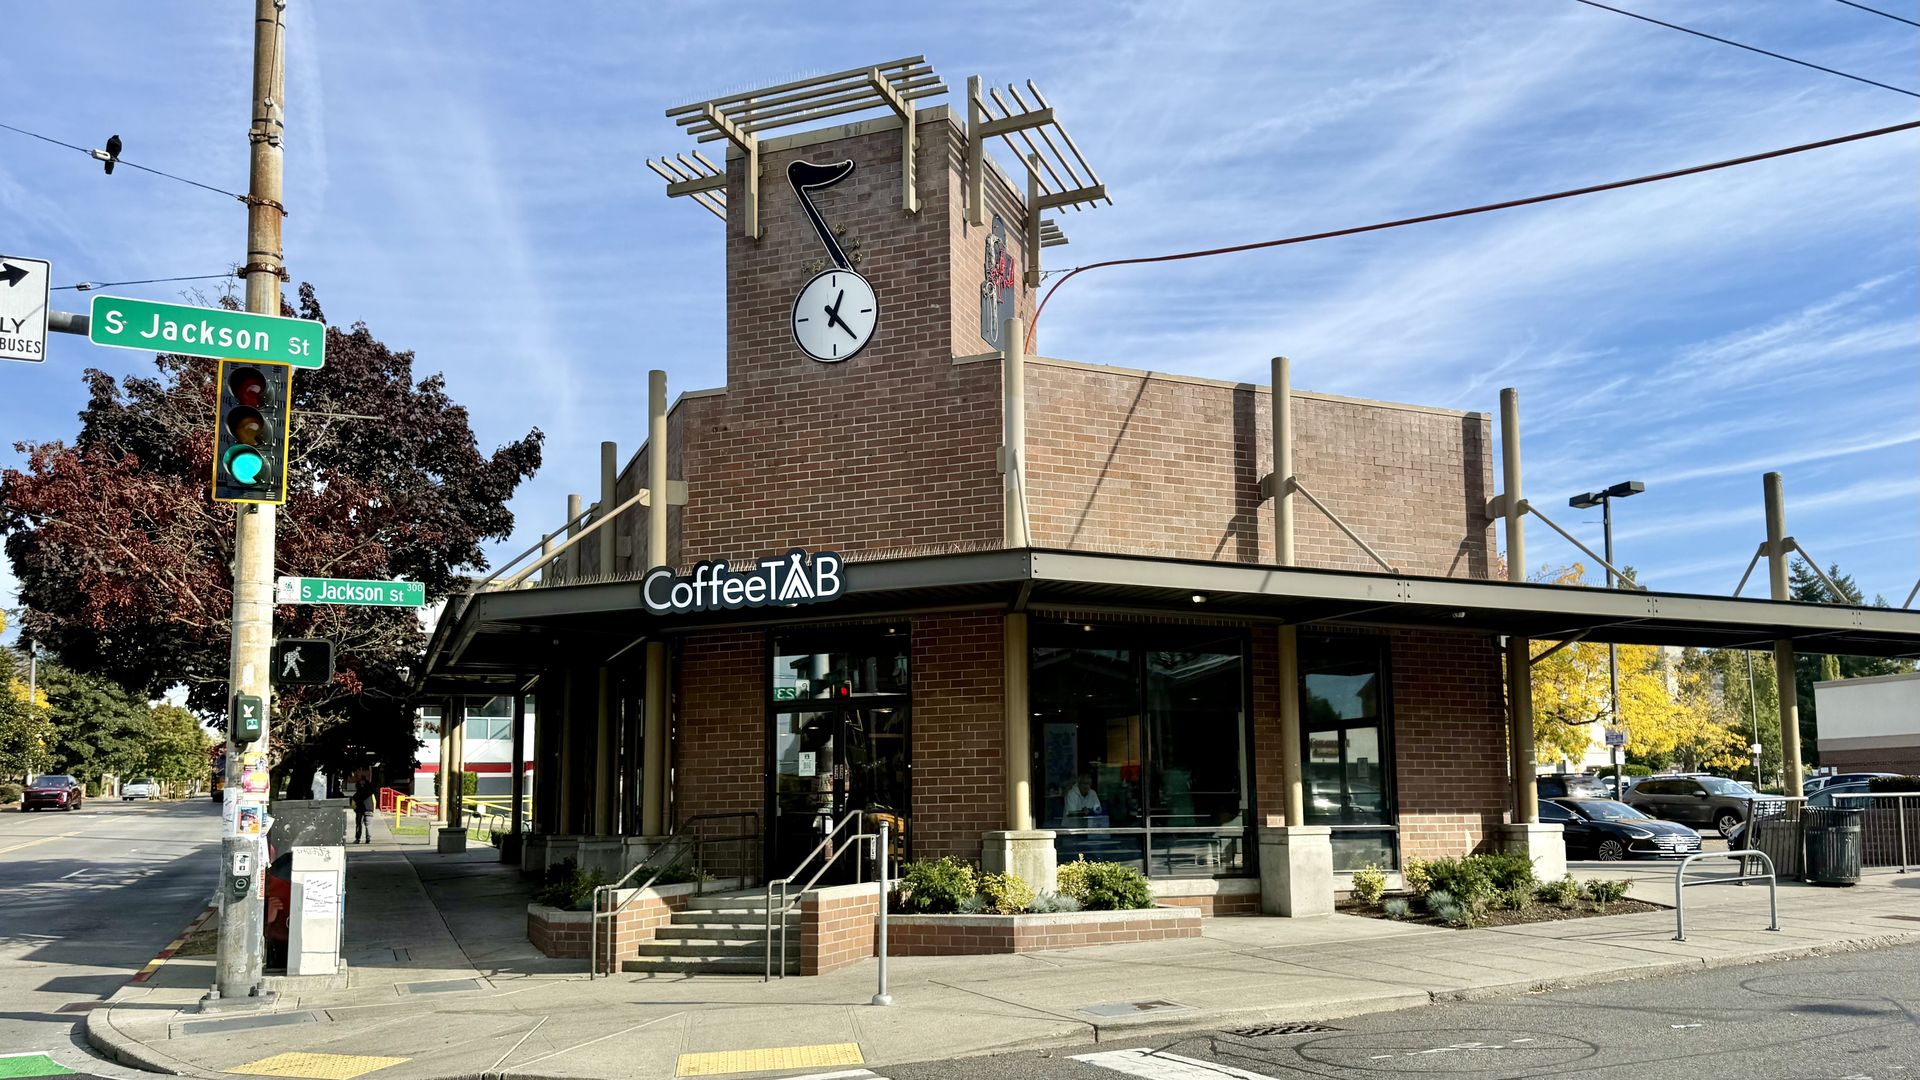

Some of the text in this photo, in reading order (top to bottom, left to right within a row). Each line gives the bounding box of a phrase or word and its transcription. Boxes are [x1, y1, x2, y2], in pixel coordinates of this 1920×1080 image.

[0, 316, 26, 334] LY
[104, 310, 310, 356] S Jackson St
[0, 337, 42, 354] BUSES
[406, 583, 424, 592] 300
[643, 553, 840, 610] CoffeeTAB
[302, 581, 404, 602] S Jackson St
